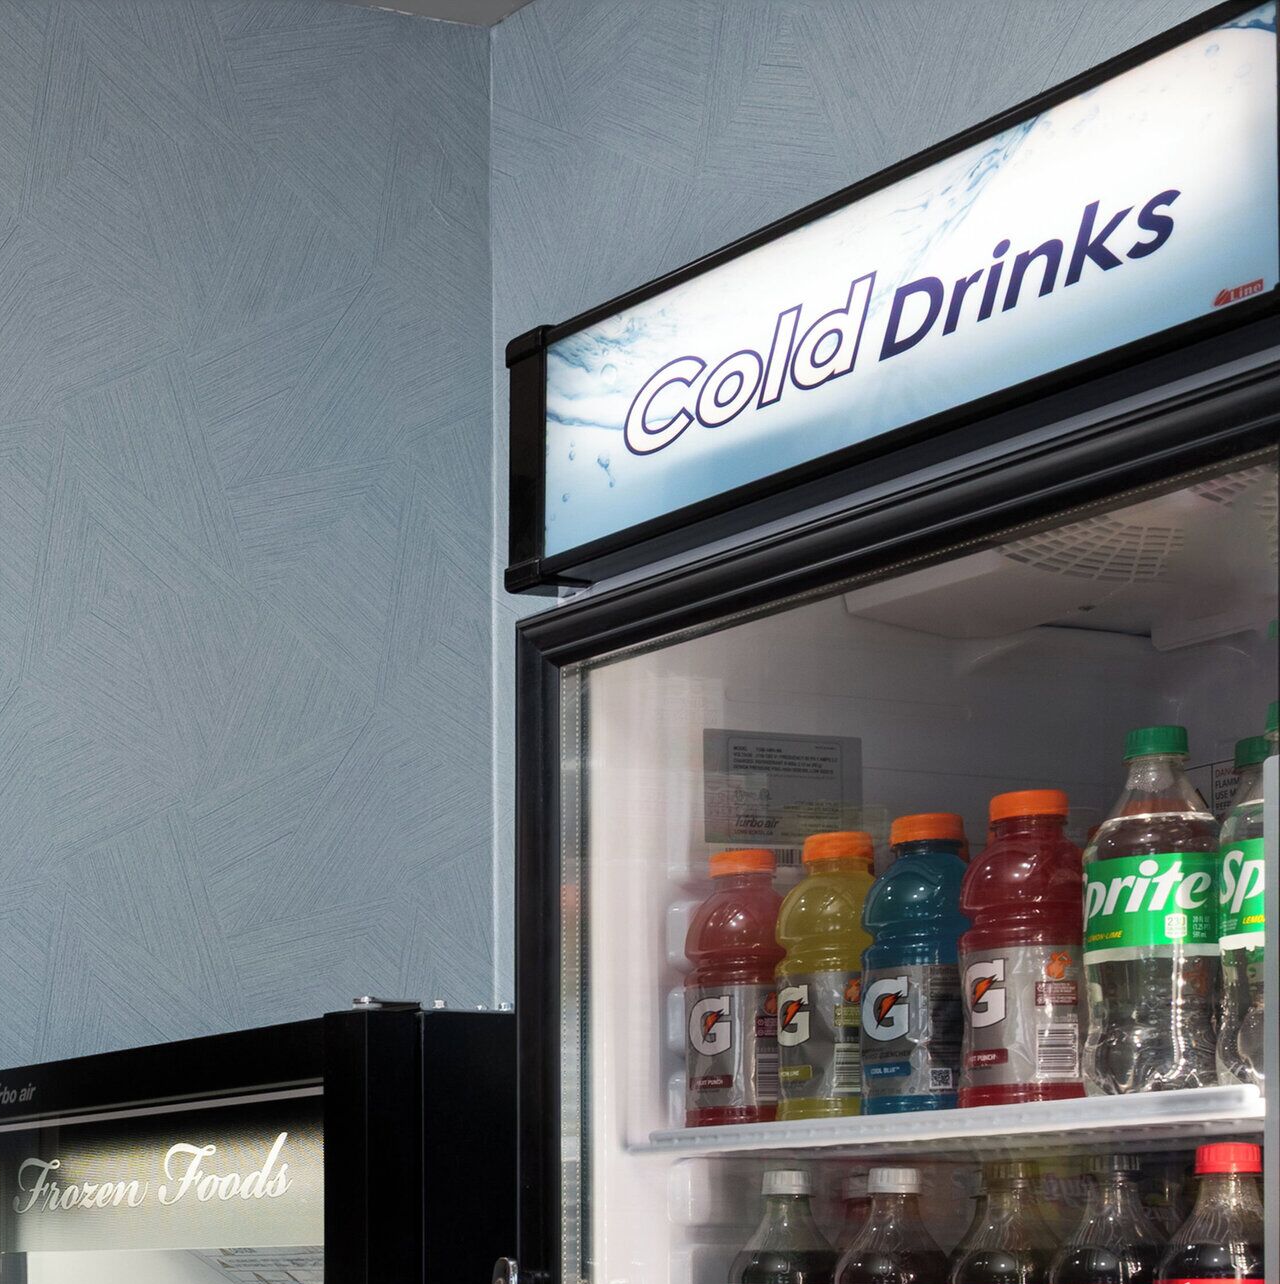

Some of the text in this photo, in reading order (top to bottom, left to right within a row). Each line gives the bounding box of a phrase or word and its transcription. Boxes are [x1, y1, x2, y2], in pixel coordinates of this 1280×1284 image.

[624, 189, 1181, 456] Cold Drinks
[1083, 860, 1212, 931] prite
[690, 995, 732, 1056] G
[778, 984, 810, 1047] G
[862, 975, 910, 1042] G
[966, 958, 1007, 1028] G
[19, 1083, 36, 1102] air
[13, 1131, 292, 1215] Frozen Foods
